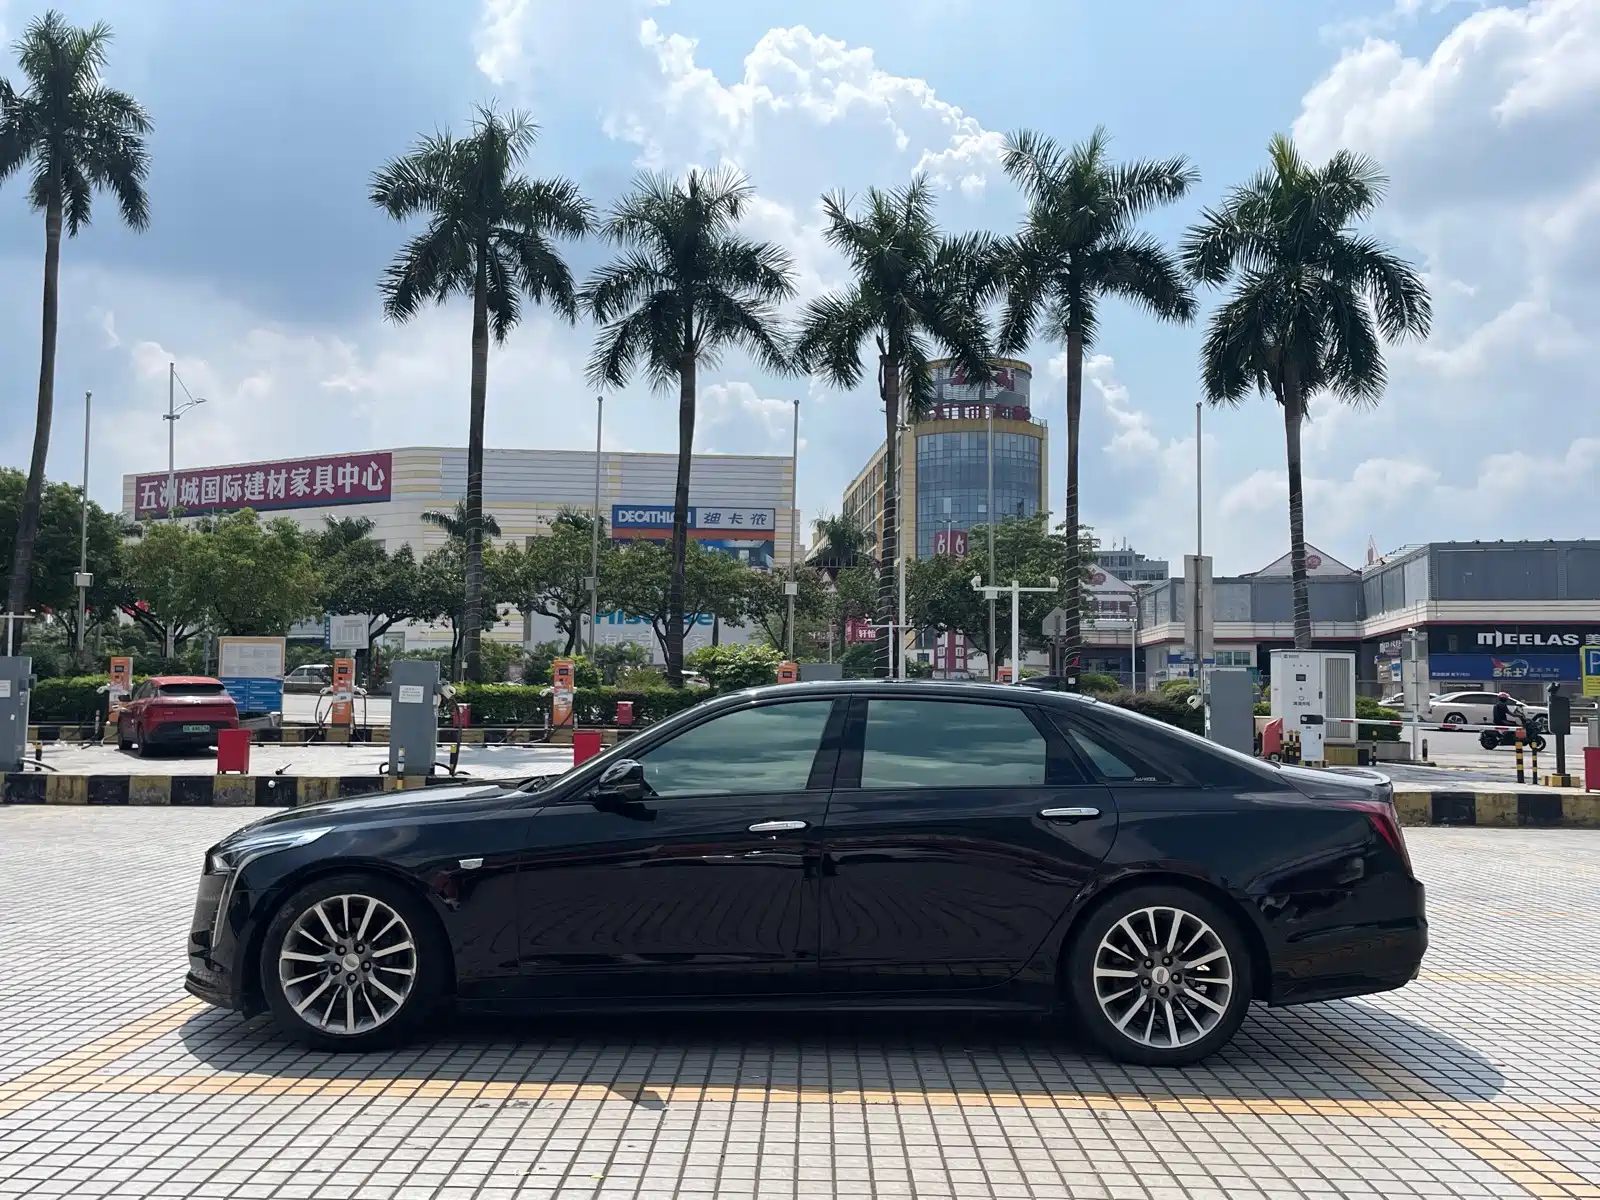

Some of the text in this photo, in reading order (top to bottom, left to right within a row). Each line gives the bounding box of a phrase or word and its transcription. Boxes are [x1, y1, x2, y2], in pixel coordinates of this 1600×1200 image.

[139, 461, 386, 510] 五洲城国际建材家具中心
[618, 510, 691, 523] DECATHL
[1477, 629, 1580, 647] MEELAS
[1492, 667, 1522, 678] 多乐士
